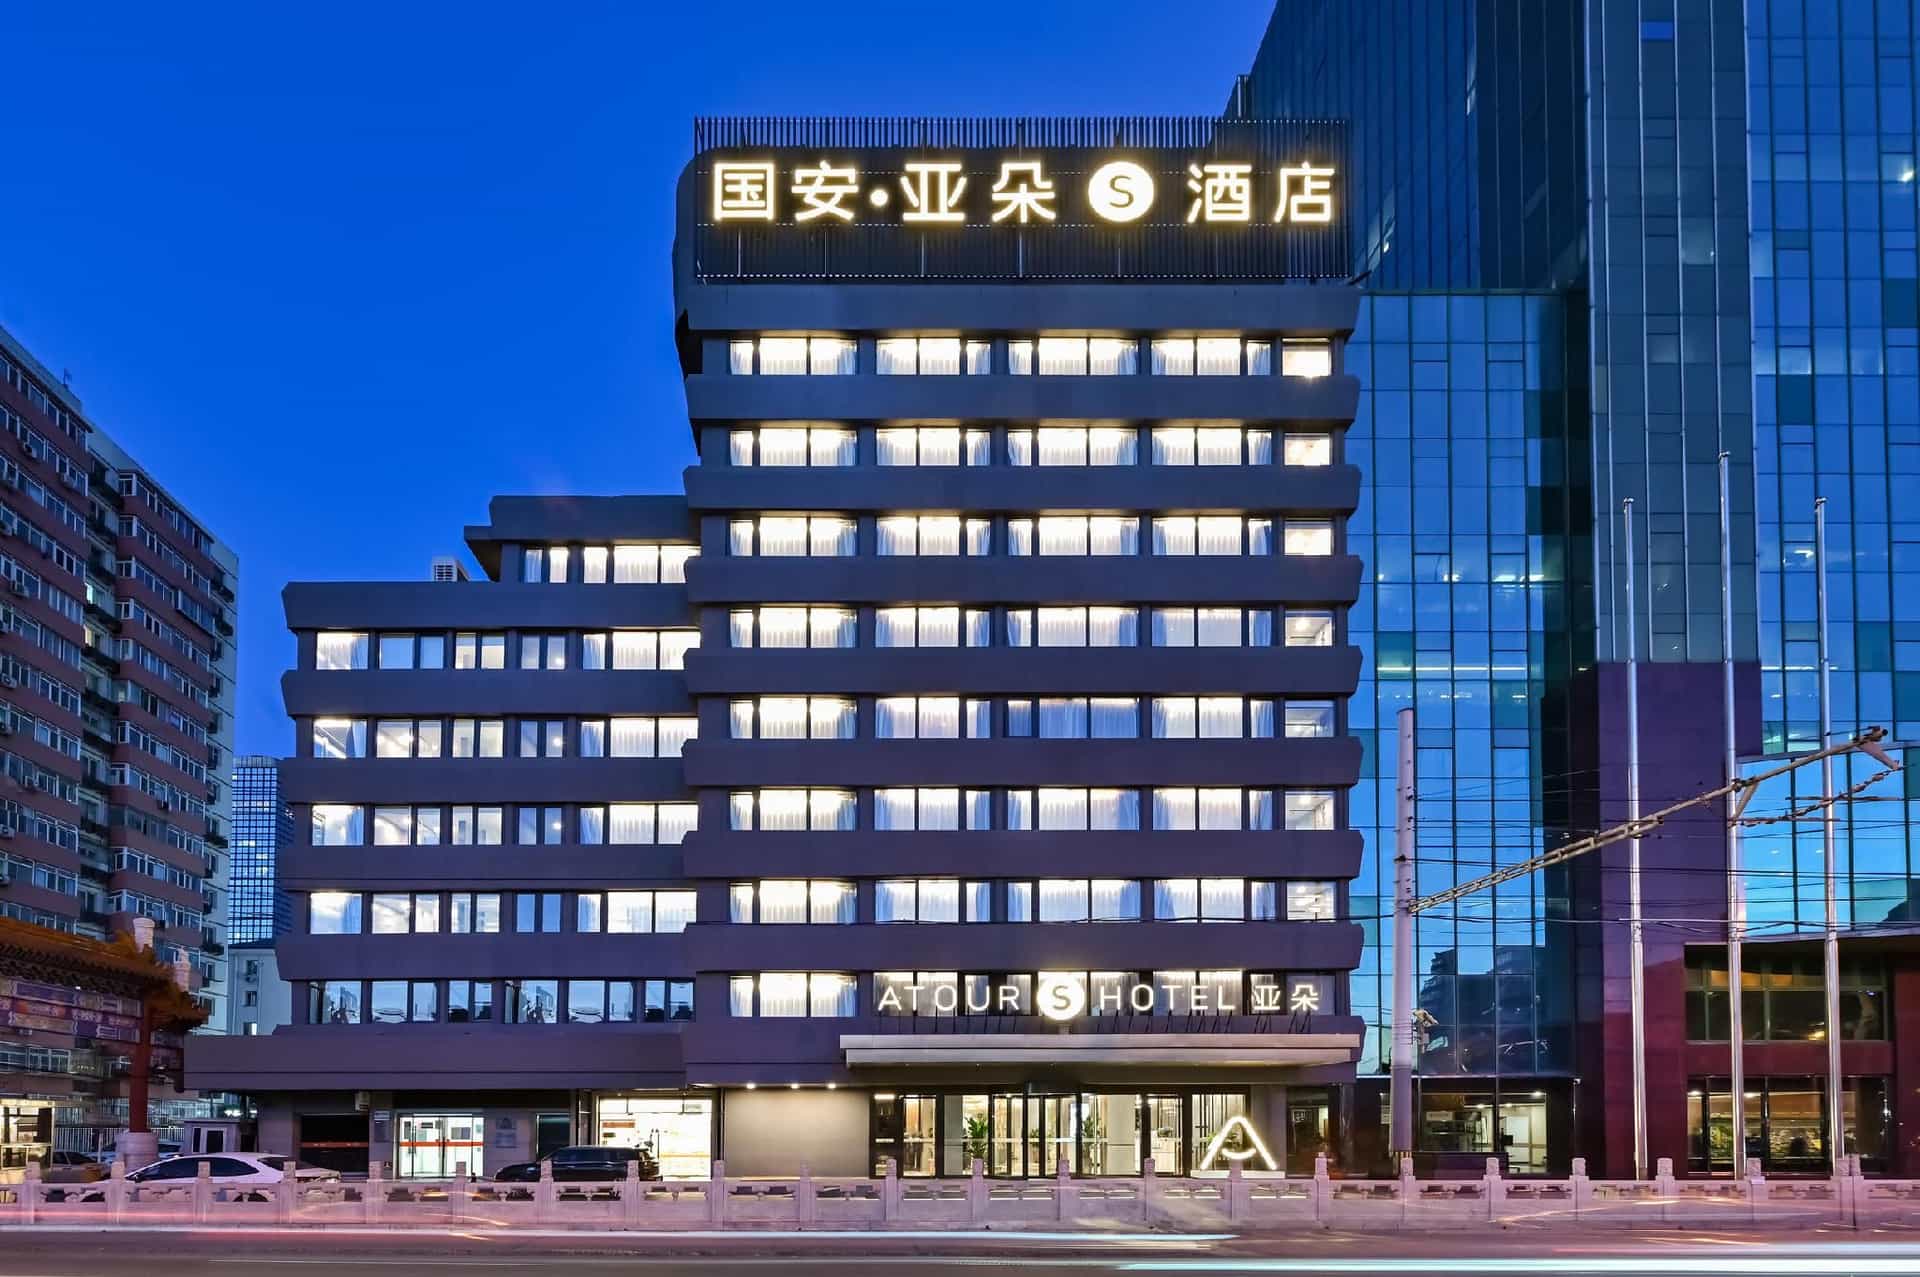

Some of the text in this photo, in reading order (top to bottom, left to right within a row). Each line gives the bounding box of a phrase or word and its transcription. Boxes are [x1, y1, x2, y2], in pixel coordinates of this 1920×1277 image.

[1187, 162, 1335, 223] 酒店
[878, 984, 1020, 1011] ATOUR
[1100, 983, 1235, 1011] HOTEL
[1253, 984, 1319, 1011] 亚朵
